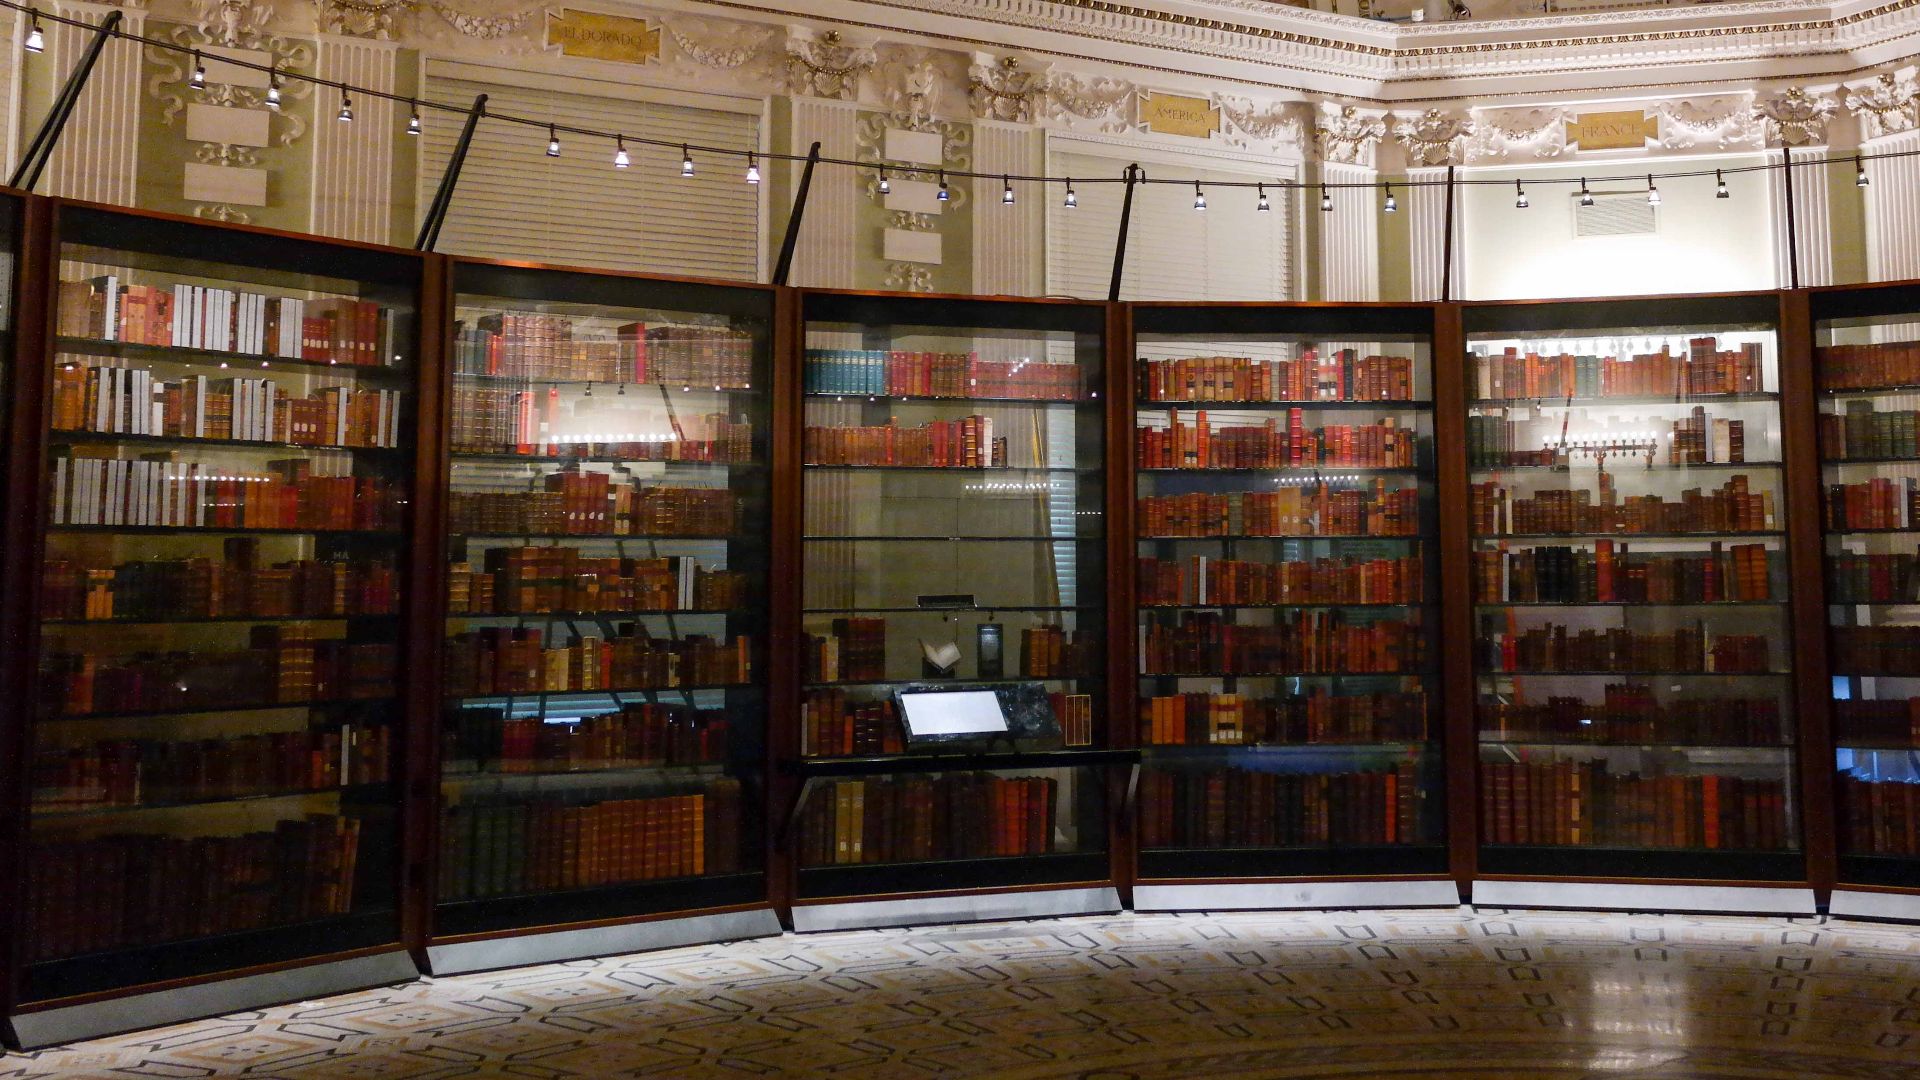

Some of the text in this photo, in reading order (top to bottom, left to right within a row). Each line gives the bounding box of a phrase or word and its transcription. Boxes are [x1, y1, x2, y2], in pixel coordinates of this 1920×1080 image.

[564, 26, 642, 46] EL DORADO
[1154, 106, 1206, 124] AMERICA
[1582, 123, 1640, 138] FRANCE
